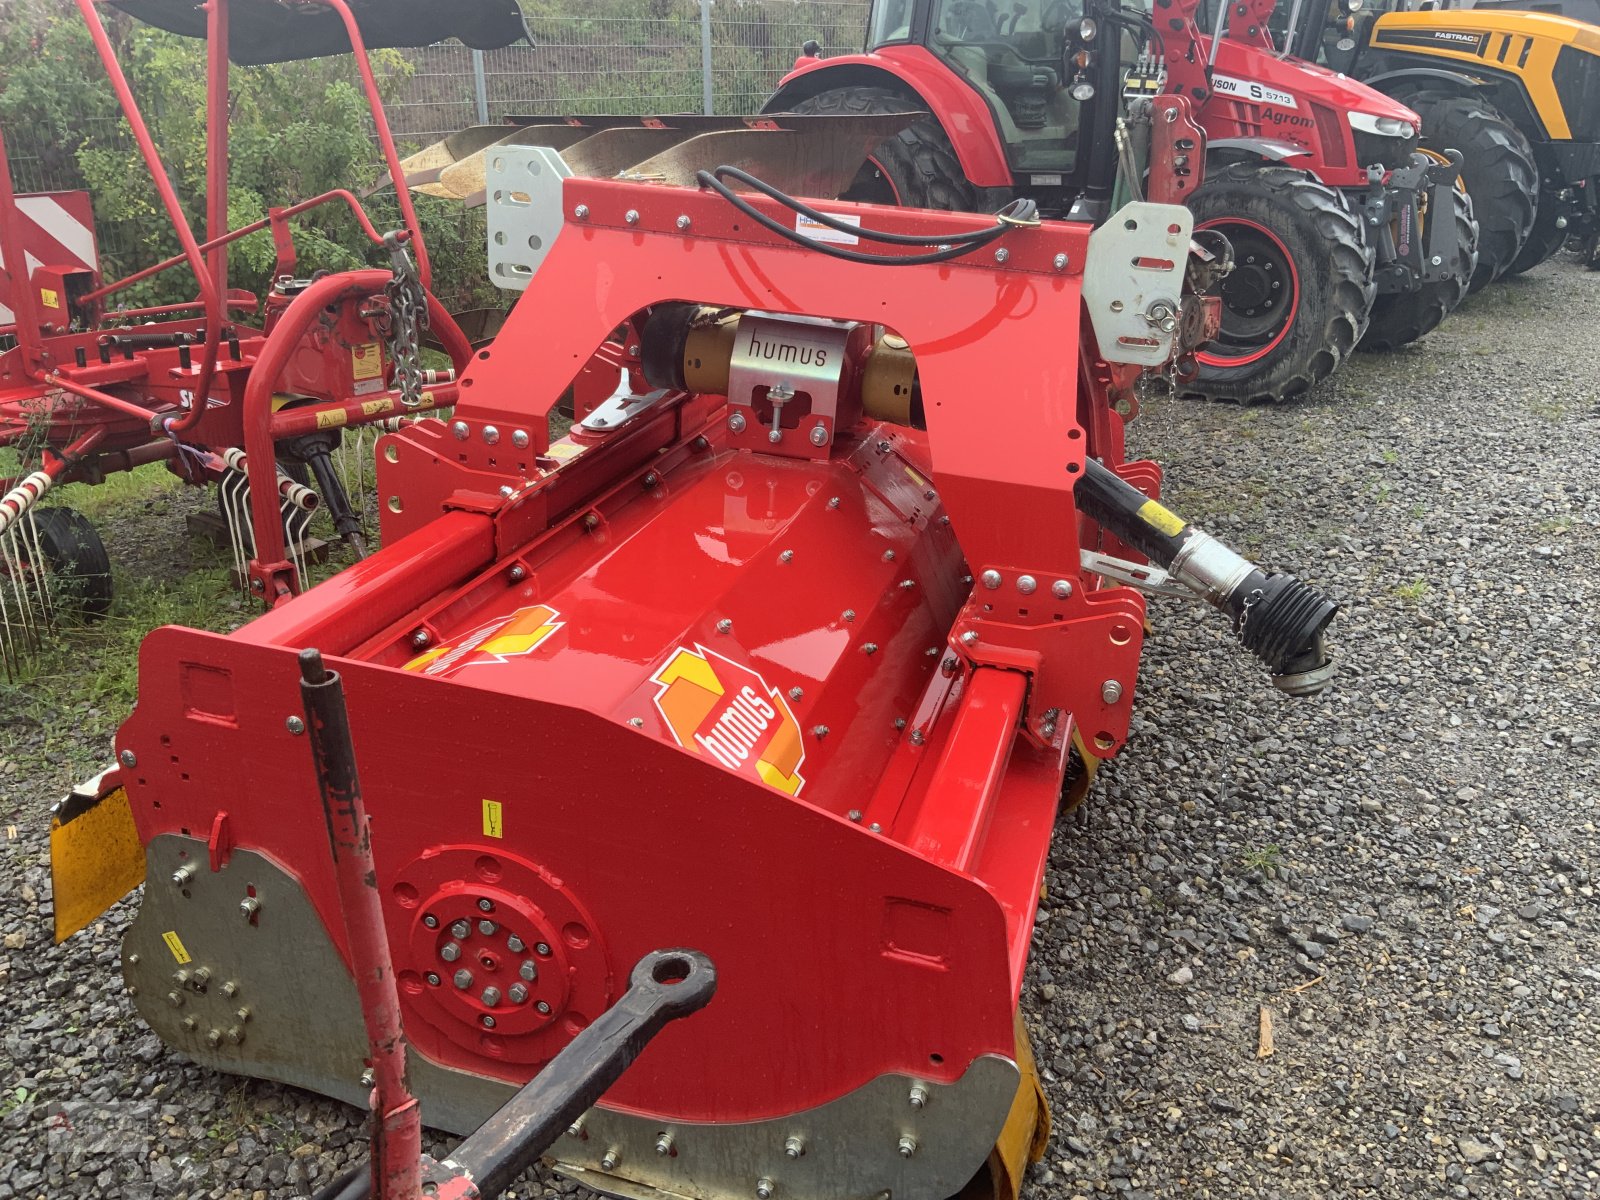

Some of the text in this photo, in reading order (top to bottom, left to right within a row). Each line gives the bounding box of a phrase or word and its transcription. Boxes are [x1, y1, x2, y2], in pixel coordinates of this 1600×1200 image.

[1435, 32, 1474, 42] FASTRAC
[1250, 85, 1262, 98] S
[1266, 91, 1291, 104] 5713
[1262, 108, 1315, 128] Agrom
[749, 328, 827, 367] humus
[693, 685, 775, 771] humus
